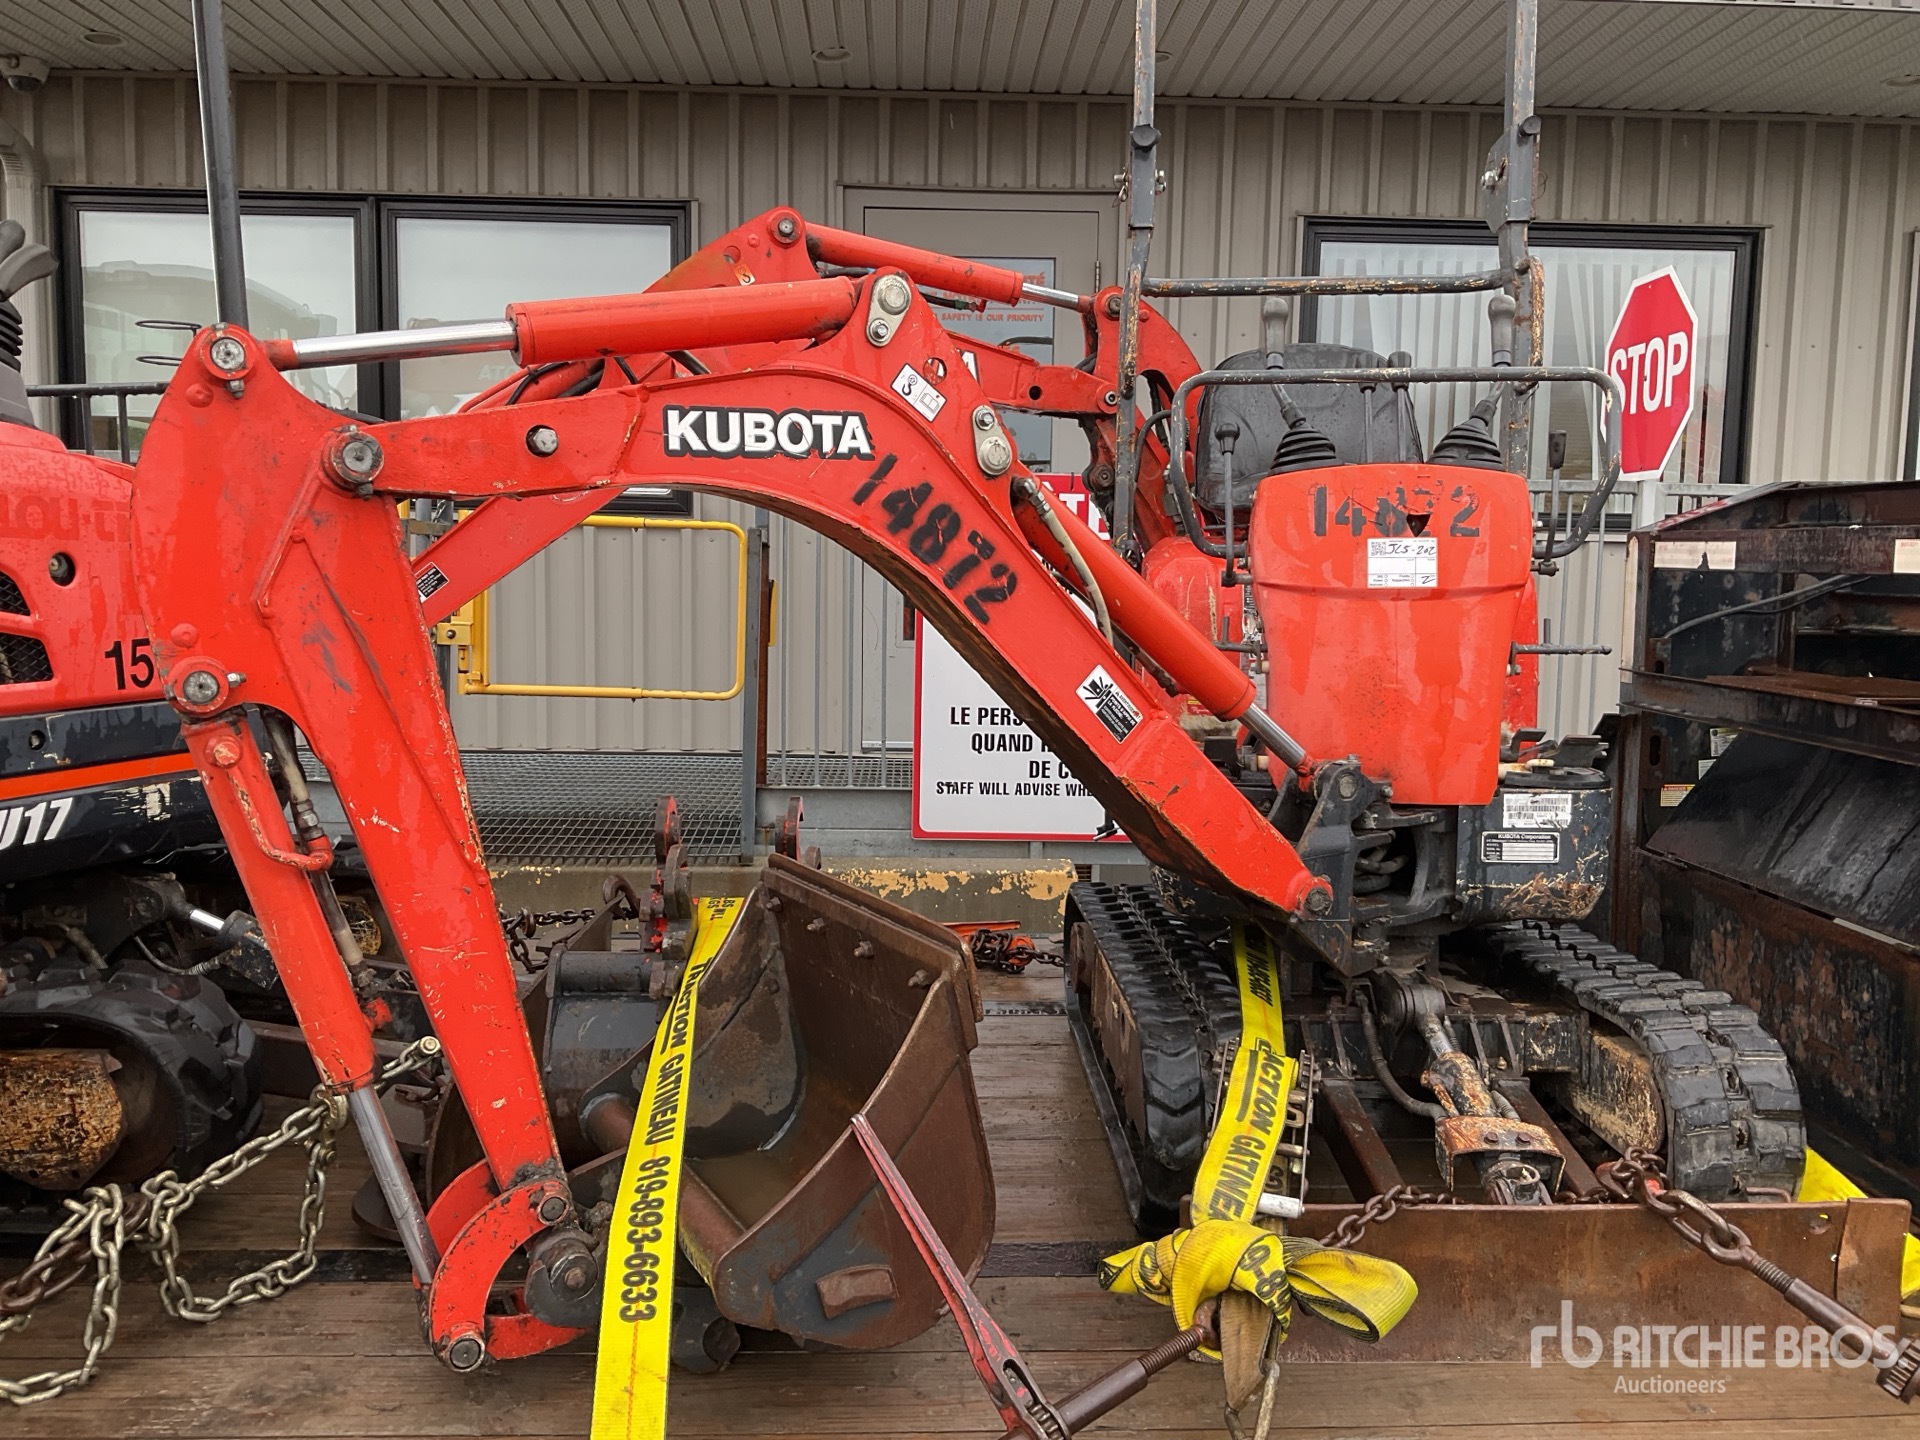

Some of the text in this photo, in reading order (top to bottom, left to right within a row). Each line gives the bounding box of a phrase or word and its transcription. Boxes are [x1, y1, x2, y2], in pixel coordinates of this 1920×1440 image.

[941, 313, 971, 321] SAFETY
[986, 313, 1004, 321] OUR
[1006, 314, 1045, 322] PRIORITY
[1610, 331, 1688, 415] STOP
[666, 408, 872, 455] KUBOTA
[852, 453, 1018, 625] 14872
[104, 637, 155, 691] 15
[950, 707, 970, 725] LE
[971, 733, 1033, 754] QUAND
[936, 781, 974, 795] STAFF
[979, 782, 1009, 795] WILL
[1014, 782, 1060, 796] ADVISE
[1029, 760, 1051, 778] DE
[644, 1053, 685, 1146] GATINEAU
[619, 1155, 671, 1323] 819-893-6633
